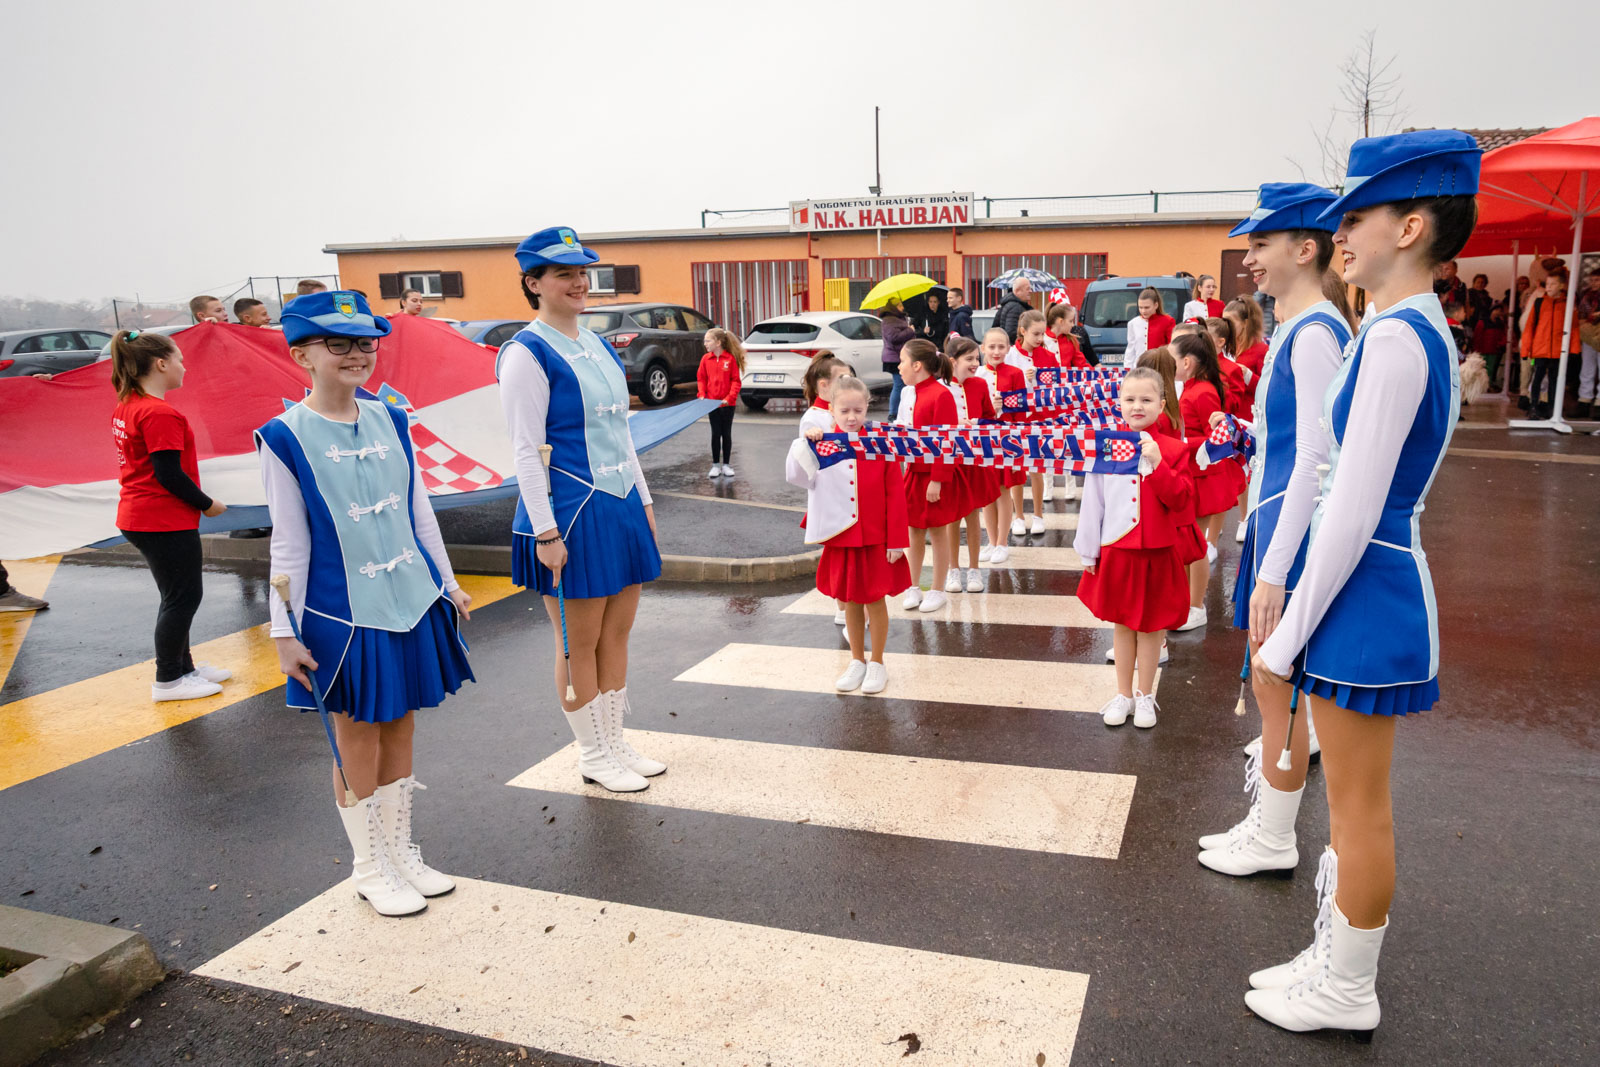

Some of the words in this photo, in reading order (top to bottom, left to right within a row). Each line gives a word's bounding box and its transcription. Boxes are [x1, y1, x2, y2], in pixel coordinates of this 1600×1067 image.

[814, 200, 871, 209] NOGOMETNO
[875, 196, 926, 206] IGRALIŠTE
[930, 195, 969, 204] BRNASI
[814, 210, 854, 229] N.K.
[859, 205, 968, 227] HALUBJAN
[859, 434, 1085, 461] HRVATSKA
